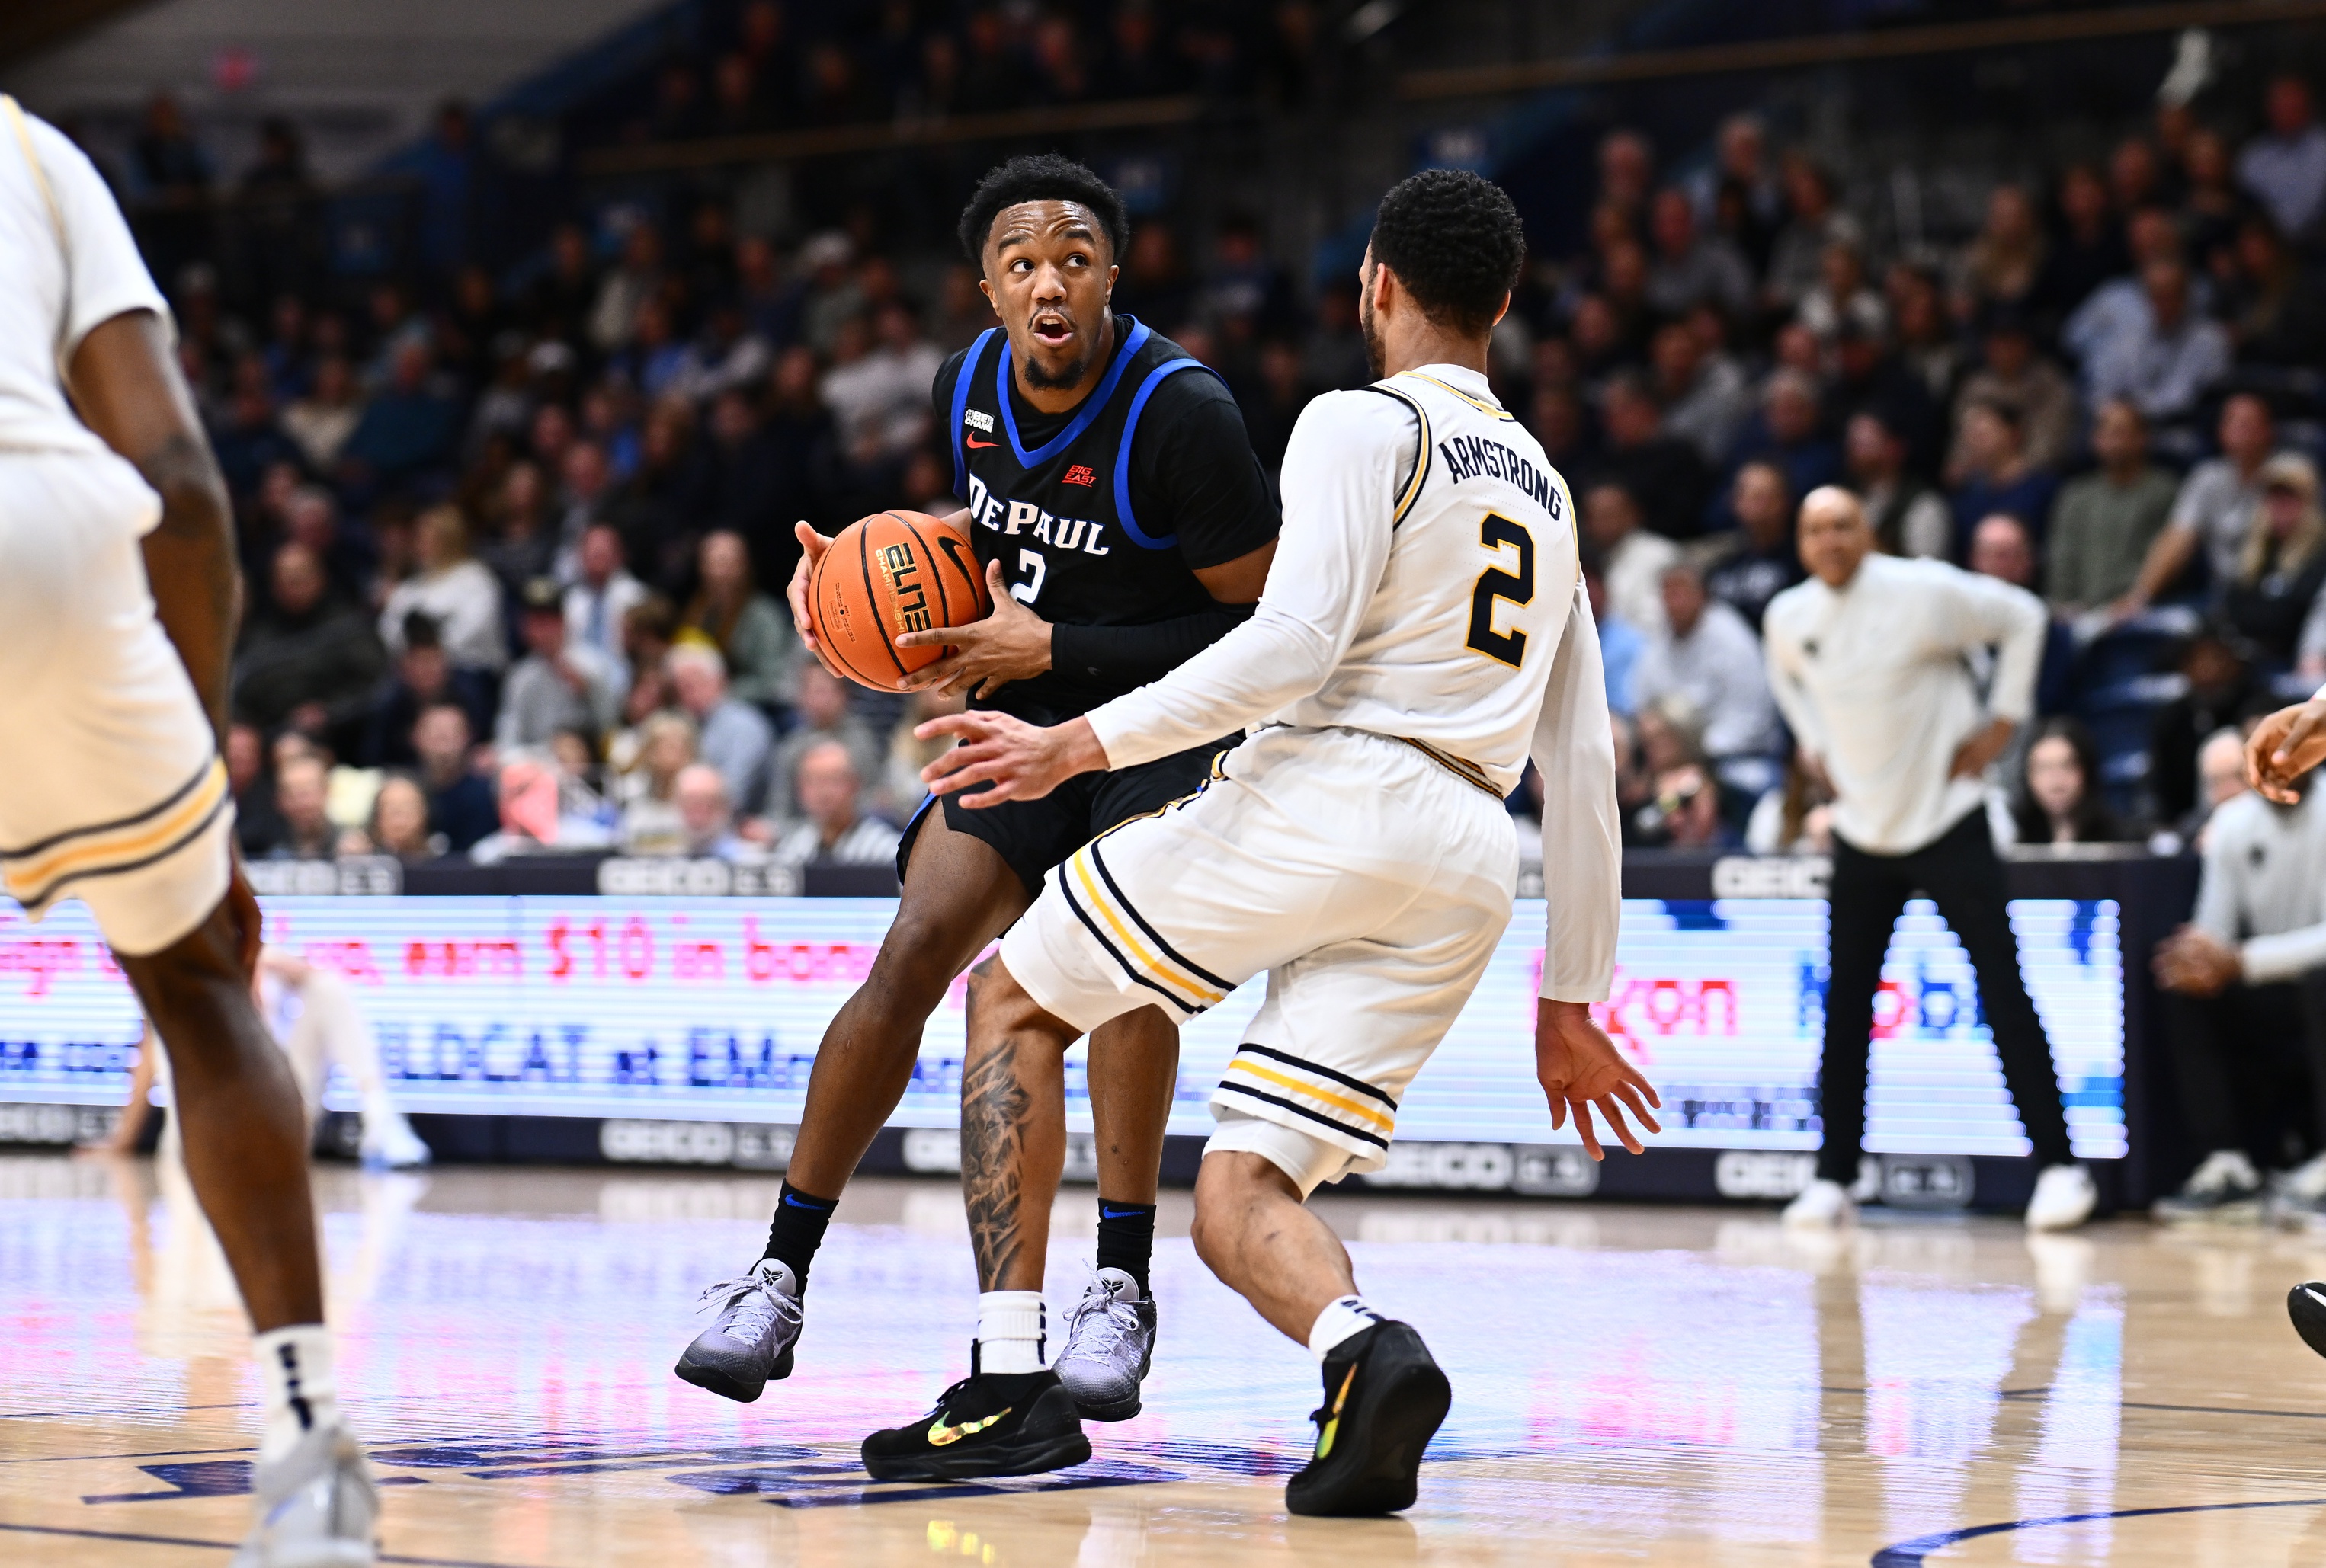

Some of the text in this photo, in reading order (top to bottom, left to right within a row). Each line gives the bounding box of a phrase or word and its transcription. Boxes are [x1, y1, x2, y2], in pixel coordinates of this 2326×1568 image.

[964, 418, 992, 434] CHANG
[1064, 473, 1097, 485] EAST
[1069, 465, 1094, 476] BIG
[1438, 434, 1562, 522] ARMSTRONG
[875, 548, 908, 635] CHAMPIONSHI
[883, 542, 933, 634] ELITE
[1009, 548, 1047, 604] 2
[1465, 510, 1536, 670] 2
[546, 913, 654, 983] $10
[672, 913, 724, 981] in
